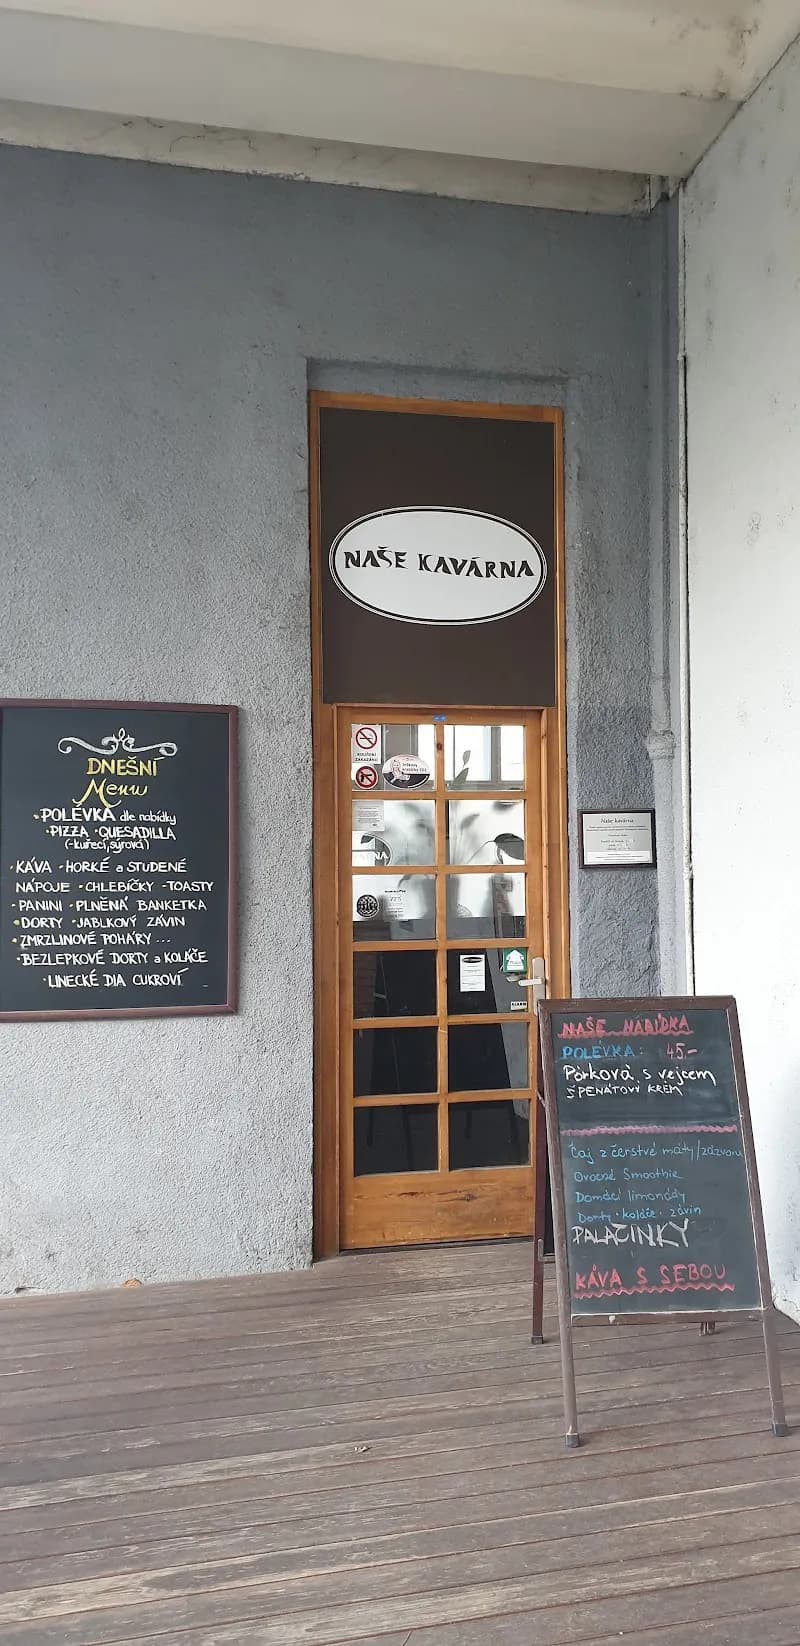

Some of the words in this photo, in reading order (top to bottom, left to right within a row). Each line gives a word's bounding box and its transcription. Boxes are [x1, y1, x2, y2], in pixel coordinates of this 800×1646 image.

[344, 545, 408, 569] NAŠE
[418, 553, 534, 579] KAVÁRNA
[86, 755, 166, 777] DNEŠNÍ
[72, 778, 148, 808] Menu
[40, 803, 116, 823] POLÉVKA
[119, 809, 136, 822] dle
[138, 810, 177, 825] nabídky
[50, 825, 89, 838] PIZZA
[98, 826, 177, 841] QUESADILLA
[15, 857, 52, 874] KÁVA
[65, 856, 110, 873] HORKÉ
[115, 864, 124, 873] a
[126, 858, 188, 873] STUDENÉ
[15, 878, 71, 893] NÁPOJE
[85, 879, 154, 892] CHLEBÍČKY
[19, 899, 63, 912] PANINI
[75, 896, 129, 912] PLNĚNÁ
[136, 899, 207, 912] BANKETKA
[21, 917, 63, 929] DORTY
[76, 915, 137, 929] JABLKOVÝ
[147, 914, 186, 928] ZÁVIN
[19, 931, 97, 948] ZMRZLINOVÉ
[101, 931, 152, 945] POHÁRY
[21, 949, 106, 966] BEZLEPKOVÉ
[109, 953, 149, 965] DORTY
[153, 956, 162, 964] a
[164, 948, 209, 964] KOLÁČE
[48, 968, 99, 988] LINECKÉ
[103, 974, 126, 987] DIA
[132, 968, 189, 986] CUKROVÍ
[561, 1015, 607, 1037] NAŠE
[563, 1062, 635, 1082] Pórková
[642, 1068, 652, 1080] s
[658, 1065, 717, 1087] vejcem
[568, 1141, 594, 1164] Čaj
[599, 1149, 607, 1158] z
[611, 1141, 656, 1159] čerstvé
[574, 1168, 616, 1182] Ovocné
[623, 1167, 685, 1181] Smoothie
[575, 1188, 621, 1203] Domácí
[627, 1188, 686, 1204] limonády
[577, 1211, 612, 1224] Dorty
[622, 1206, 657, 1220] koláče
[670, 1203, 702, 1218] závin
[571, 1217, 690, 1248] PALAČINKY
[575, 1263, 622, 1291] KÁVA
[636, 1266, 648, 1285] S
[659, 1263, 727, 1285] SEBOU
